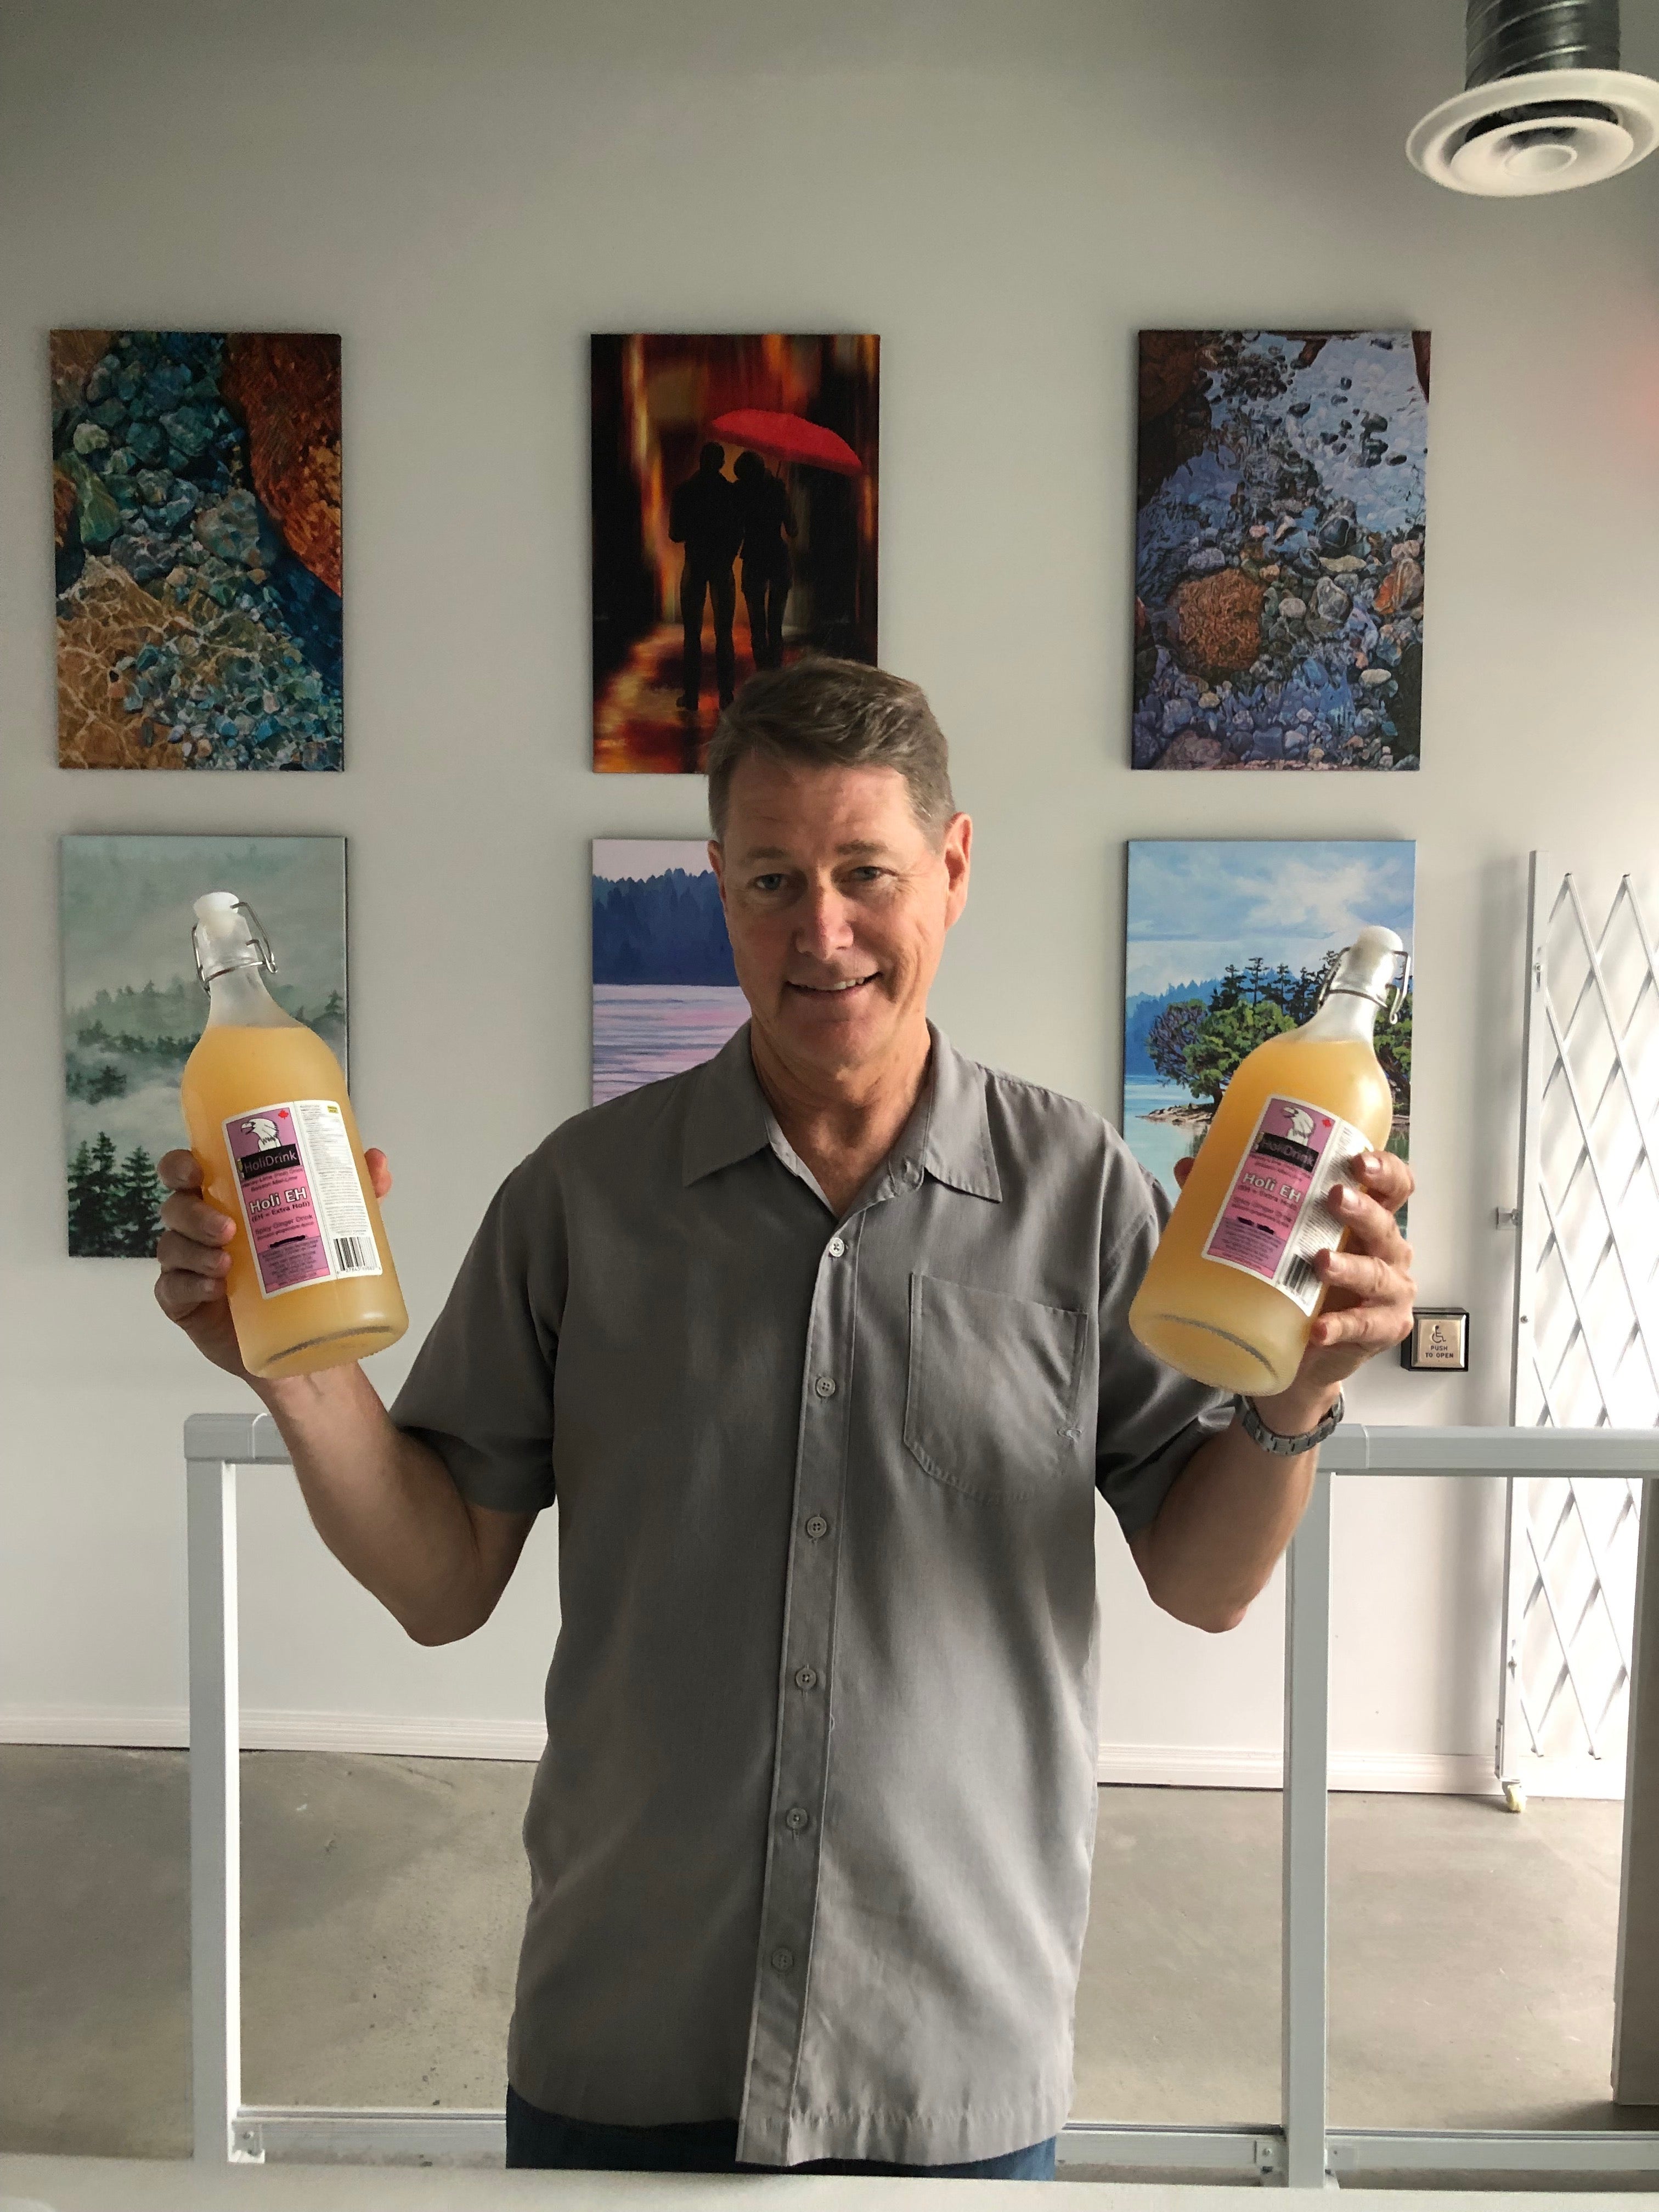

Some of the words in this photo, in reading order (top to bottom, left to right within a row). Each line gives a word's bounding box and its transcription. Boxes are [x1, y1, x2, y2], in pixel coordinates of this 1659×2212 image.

[244, 1150, 297, 1173] HoliDrink
[1243, 1172, 1277, 1191] Holi
[1279, 1184, 1301, 1203] EH
[250, 1193, 281, 1214] Holi
[284, 1187, 308, 1203] EH
[272, 1207, 291, 1215] Extra
